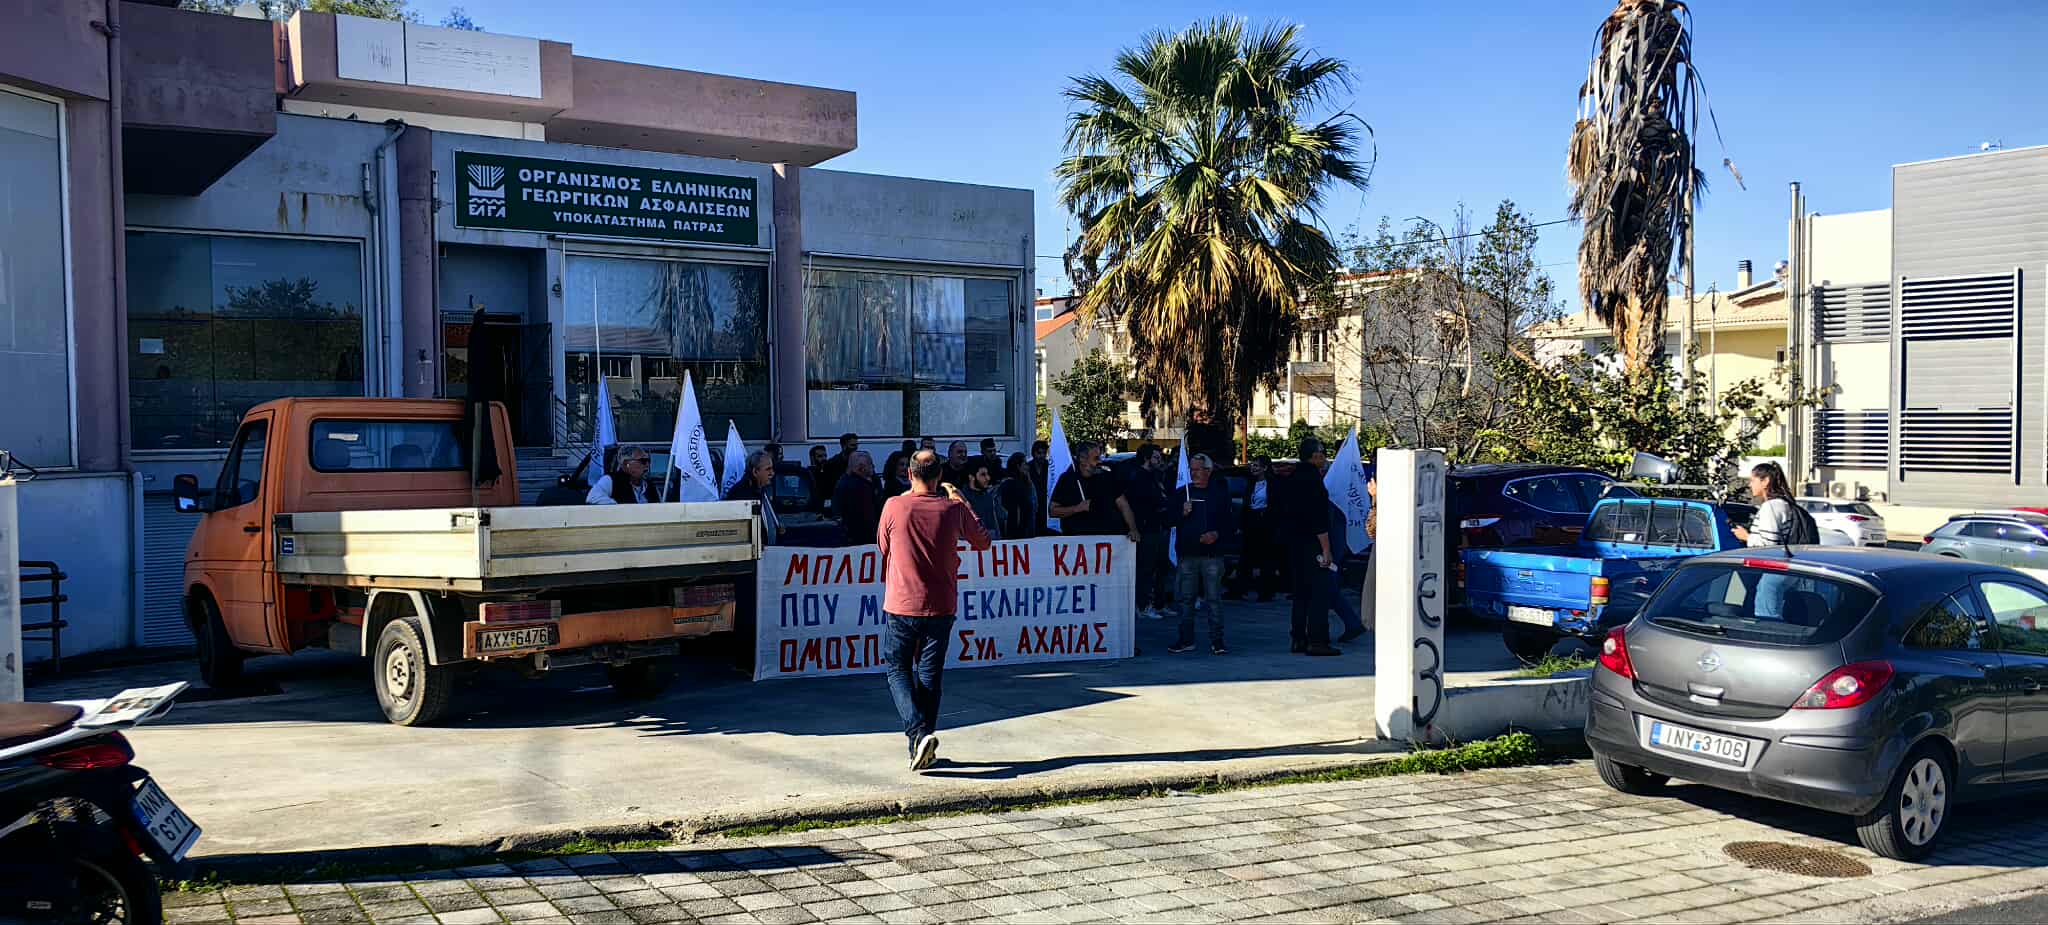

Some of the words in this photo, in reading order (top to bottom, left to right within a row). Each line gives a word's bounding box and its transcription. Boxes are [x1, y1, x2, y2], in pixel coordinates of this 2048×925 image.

[518, 168, 642, 192] ΟΡΓΑΝΙΣΜΟΣ
[651, 178, 752, 201] ΕΛΛΗΝΙΚΩΝ
[468, 203, 507, 218] ΕΛΓΑ
[521, 187, 629, 210] ΓΕΩΡΓΙΚΩΝ
[639, 197, 751, 218] ΑΣΦΑΛΙΣΕΩΝ
[552, 211, 667, 230] ΥΠΟΚΑΤΑΣΤΗΜΑ
[673, 220, 725, 234] ΠΑΤΡΑΣ
[1052, 542, 1113, 576] ΚΑΠ
[780, 592, 840, 628] ΠΟΥ
[955, 583, 1098, 621] ΕΚΛΗΡΙΖΕΙ
[779, 634, 886, 673] ΟΜΟΣΠ.
[158, 808, 188, 841] 677
